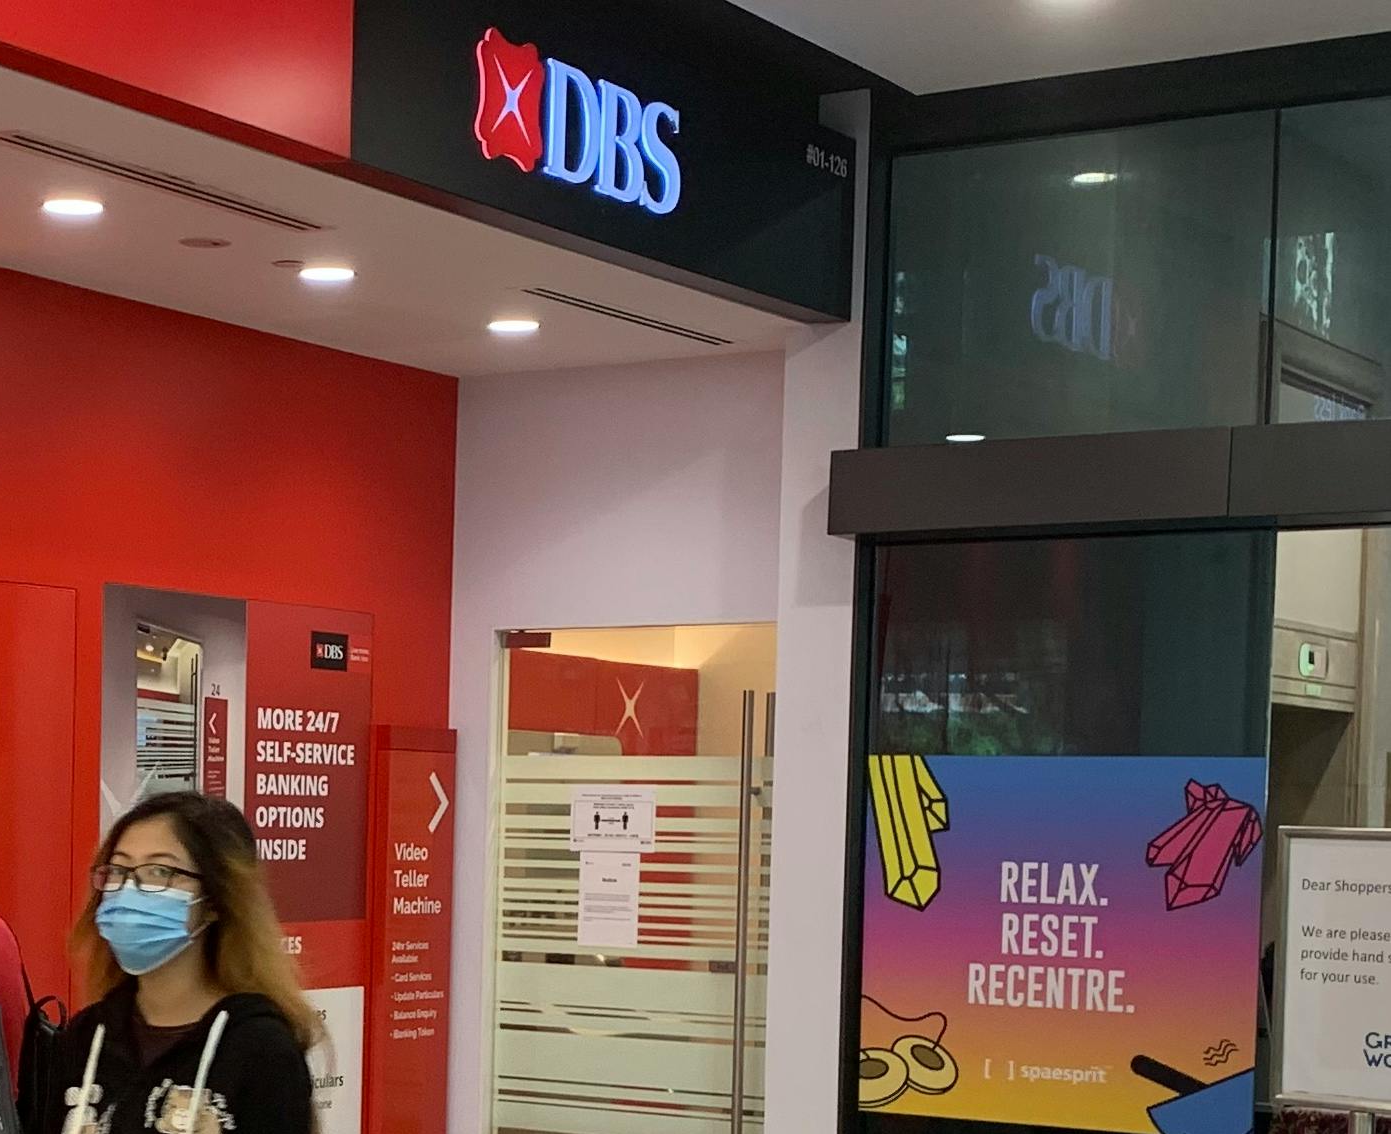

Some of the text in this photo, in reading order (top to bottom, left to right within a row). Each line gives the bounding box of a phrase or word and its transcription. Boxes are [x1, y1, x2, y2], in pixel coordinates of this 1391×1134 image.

[543, 57, 680, 215] DBS
[806, 144, 848, 178] #01-126
[324, 644, 344, 660] DBS
[257, 707, 340, 733] MORE 24/7
[256, 740, 355, 766] SELF-SERVICE
[256, 774, 329, 797] BANKING
[255, 807, 324, 829] OPTIONS
[256, 838, 307, 861] INSIDE
[395, 843, 428, 861] Video
[394, 870, 429, 888] Teller
[1000, 861, 1108, 906] RELAX.
[1301, 878, 1331, 891] Dear
[393, 897, 442, 914] Machine
[1000, 913, 1103, 959] RESET.
[1302, 925, 1323, 937] We
[1326, 928, 1346, 939] are
[1300, 948, 1349, 960] provide
[1352, 949, 1384, 963] hand
[1300, 967, 1379, 985] for your use.
[967, 963, 1135, 1013] RECENTRE.
